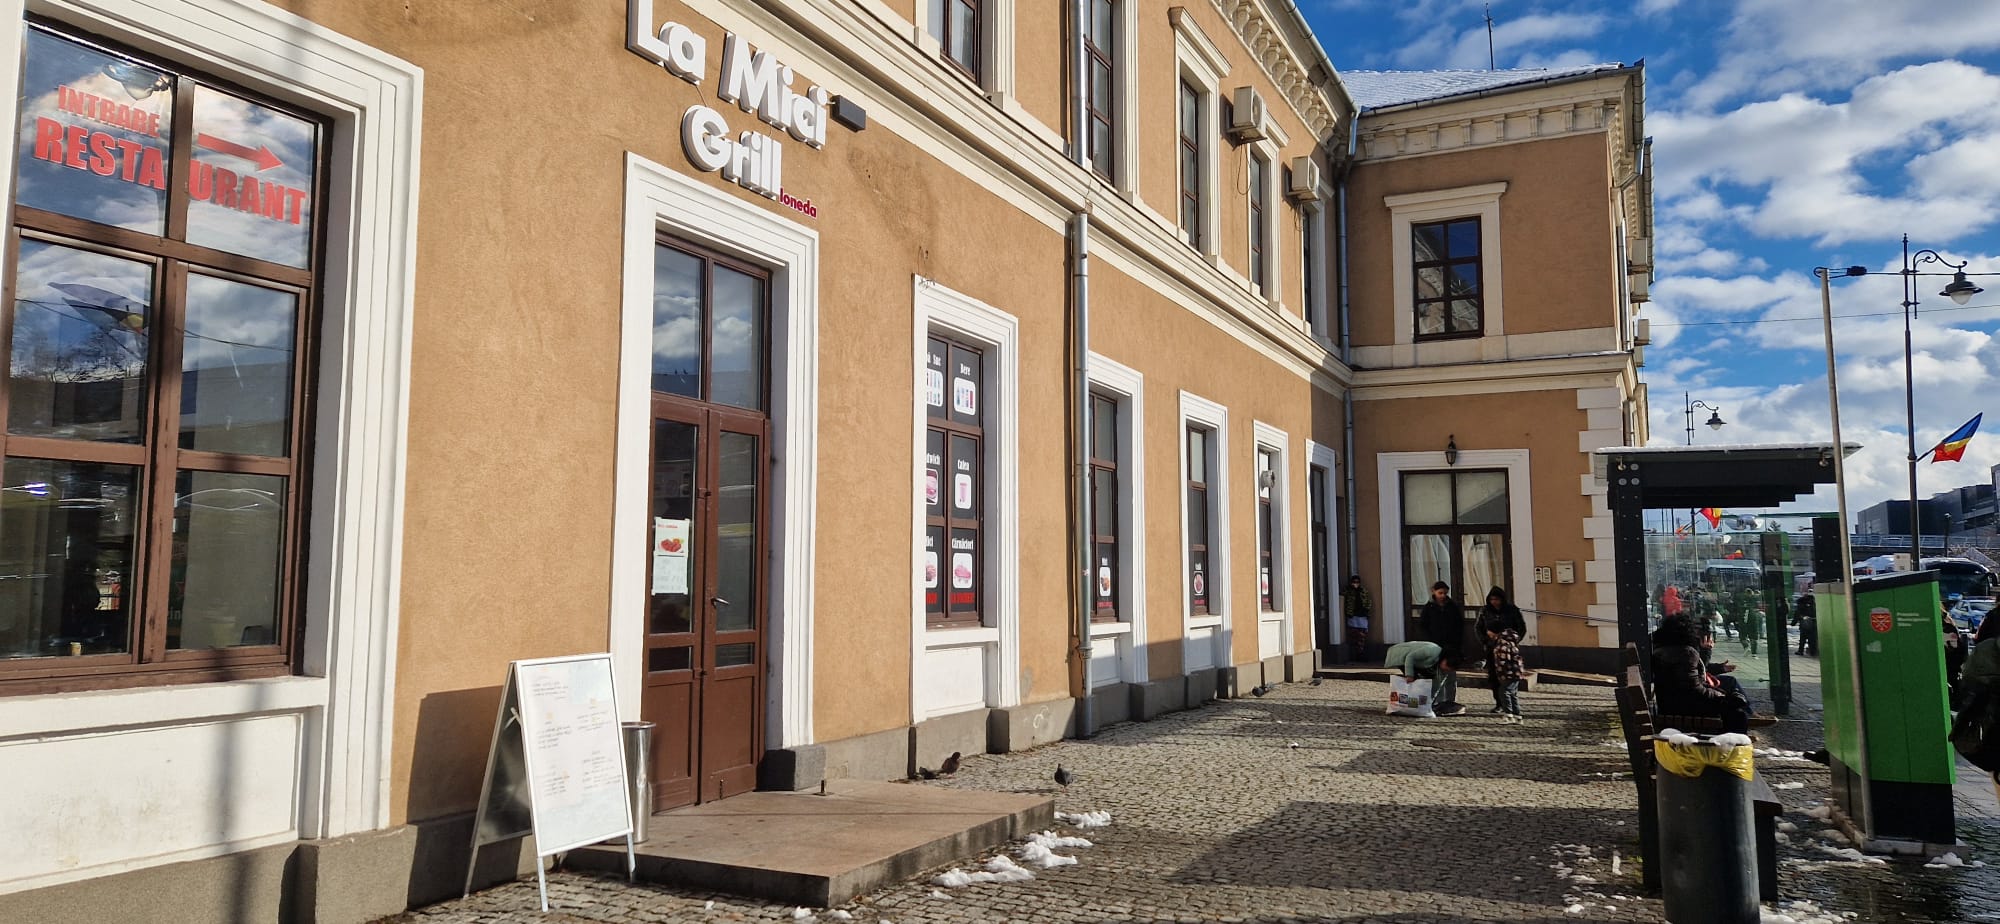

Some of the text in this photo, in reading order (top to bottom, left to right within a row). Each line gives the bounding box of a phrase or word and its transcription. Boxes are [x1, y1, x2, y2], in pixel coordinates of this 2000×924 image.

[57, 84, 161, 138] INTRARE
[629, 0, 828, 150] La Mici
[34, 116, 307, 225] RESTAURANT
[681, 105, 782, 200] Grill
